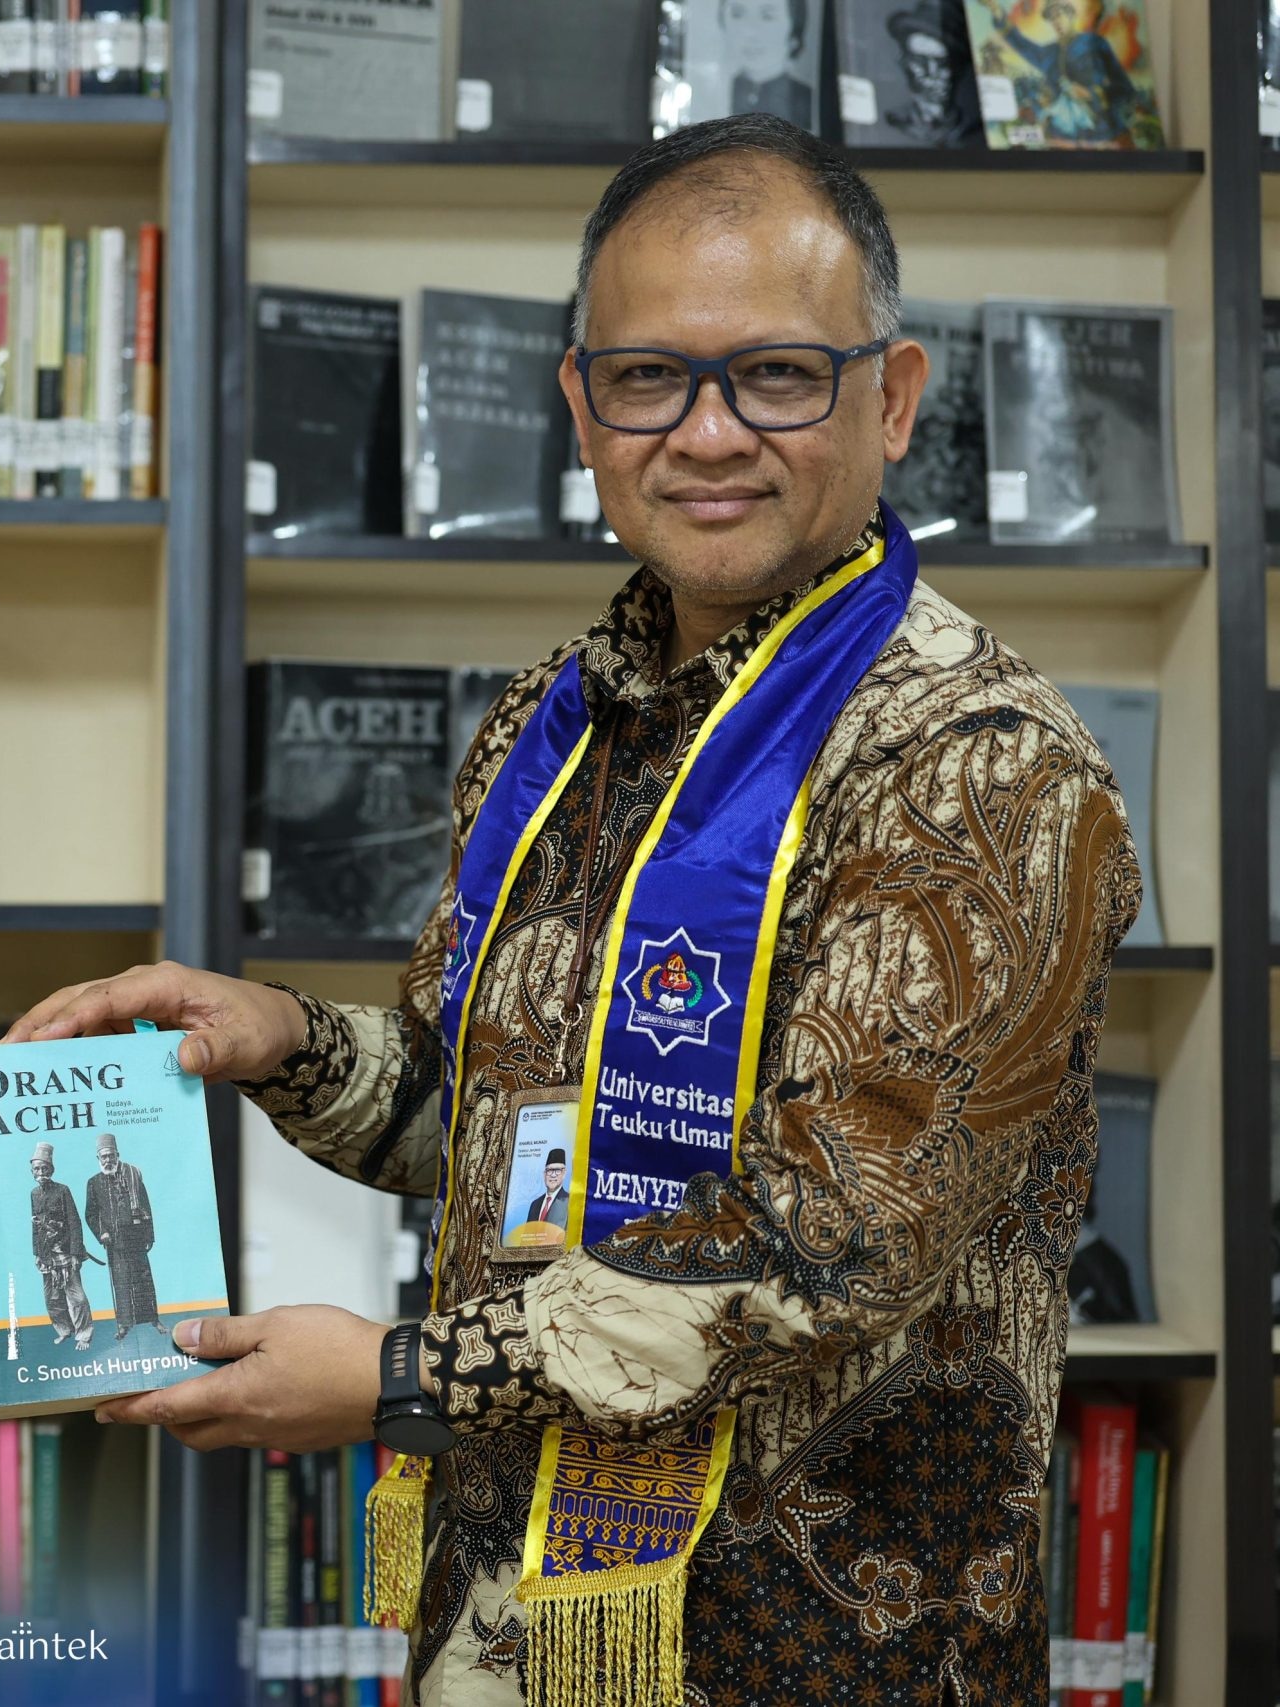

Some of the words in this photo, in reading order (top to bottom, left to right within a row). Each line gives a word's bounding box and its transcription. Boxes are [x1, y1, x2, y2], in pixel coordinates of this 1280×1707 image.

[276, 696, 442, 744] ACEH
[149, 1106, 163, 1114] dan
[600, 1066, 734, 1118] Universitas
[107, 1118, 130, 1126] Politik
[131, 1115, 160, 1125] Kolonial
[596, 1102, 663, 1140] Teuku
[668, 1118, 733, 1150] Umar
[17, 1367, 34, 1384] C.
[37, 1360, 105, 1382] Snouck
[107, 1351, 199, 1375] Hurgronje
